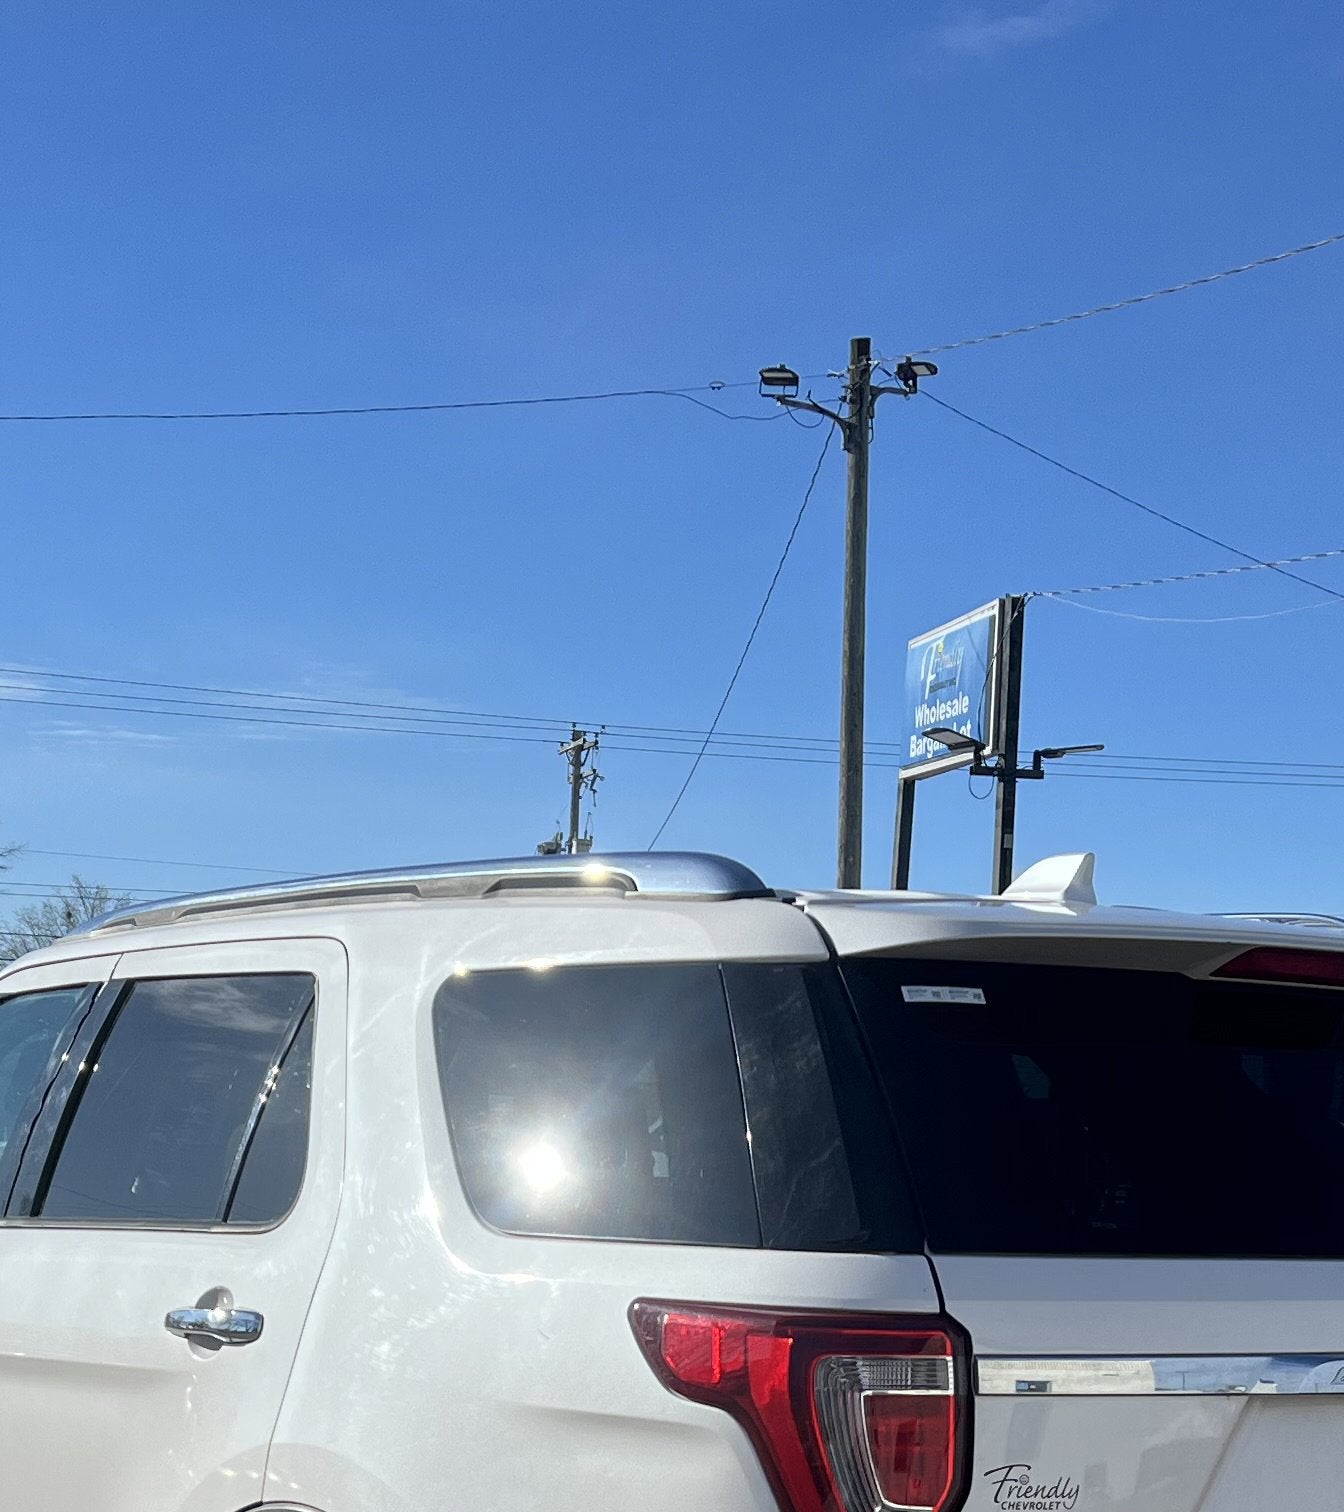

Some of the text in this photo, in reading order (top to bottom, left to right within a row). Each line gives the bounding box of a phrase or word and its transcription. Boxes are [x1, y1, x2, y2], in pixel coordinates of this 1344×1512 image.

[915, 691, 969, 728] Wholesale
[983, 1463, 1080, 1510] Friendly
[1001, 1501, 1061, 1511] CHEVROLET
